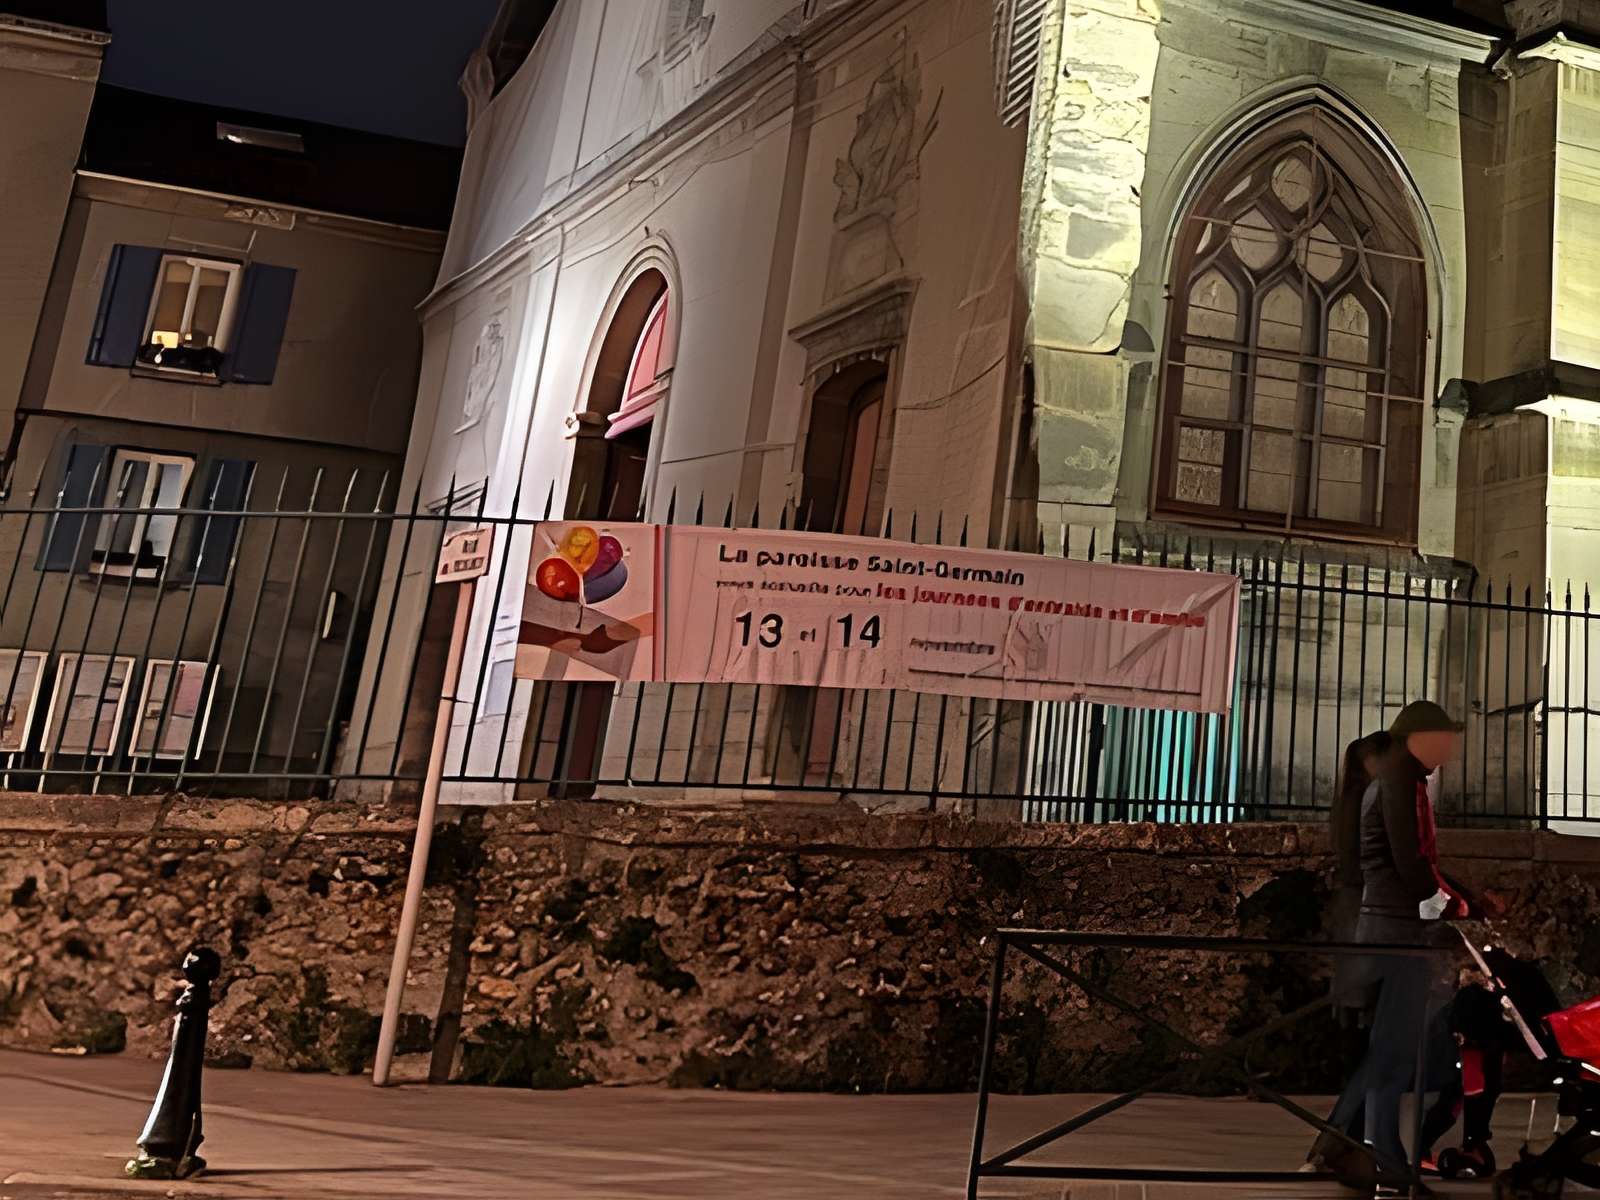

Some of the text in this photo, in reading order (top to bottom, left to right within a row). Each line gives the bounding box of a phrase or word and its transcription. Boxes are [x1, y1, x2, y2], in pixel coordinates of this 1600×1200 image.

[868, 556, 1024, 585] Saint-Germain
[736, 611, 783, 648] 13
[837, 613, 881, 648] 14
